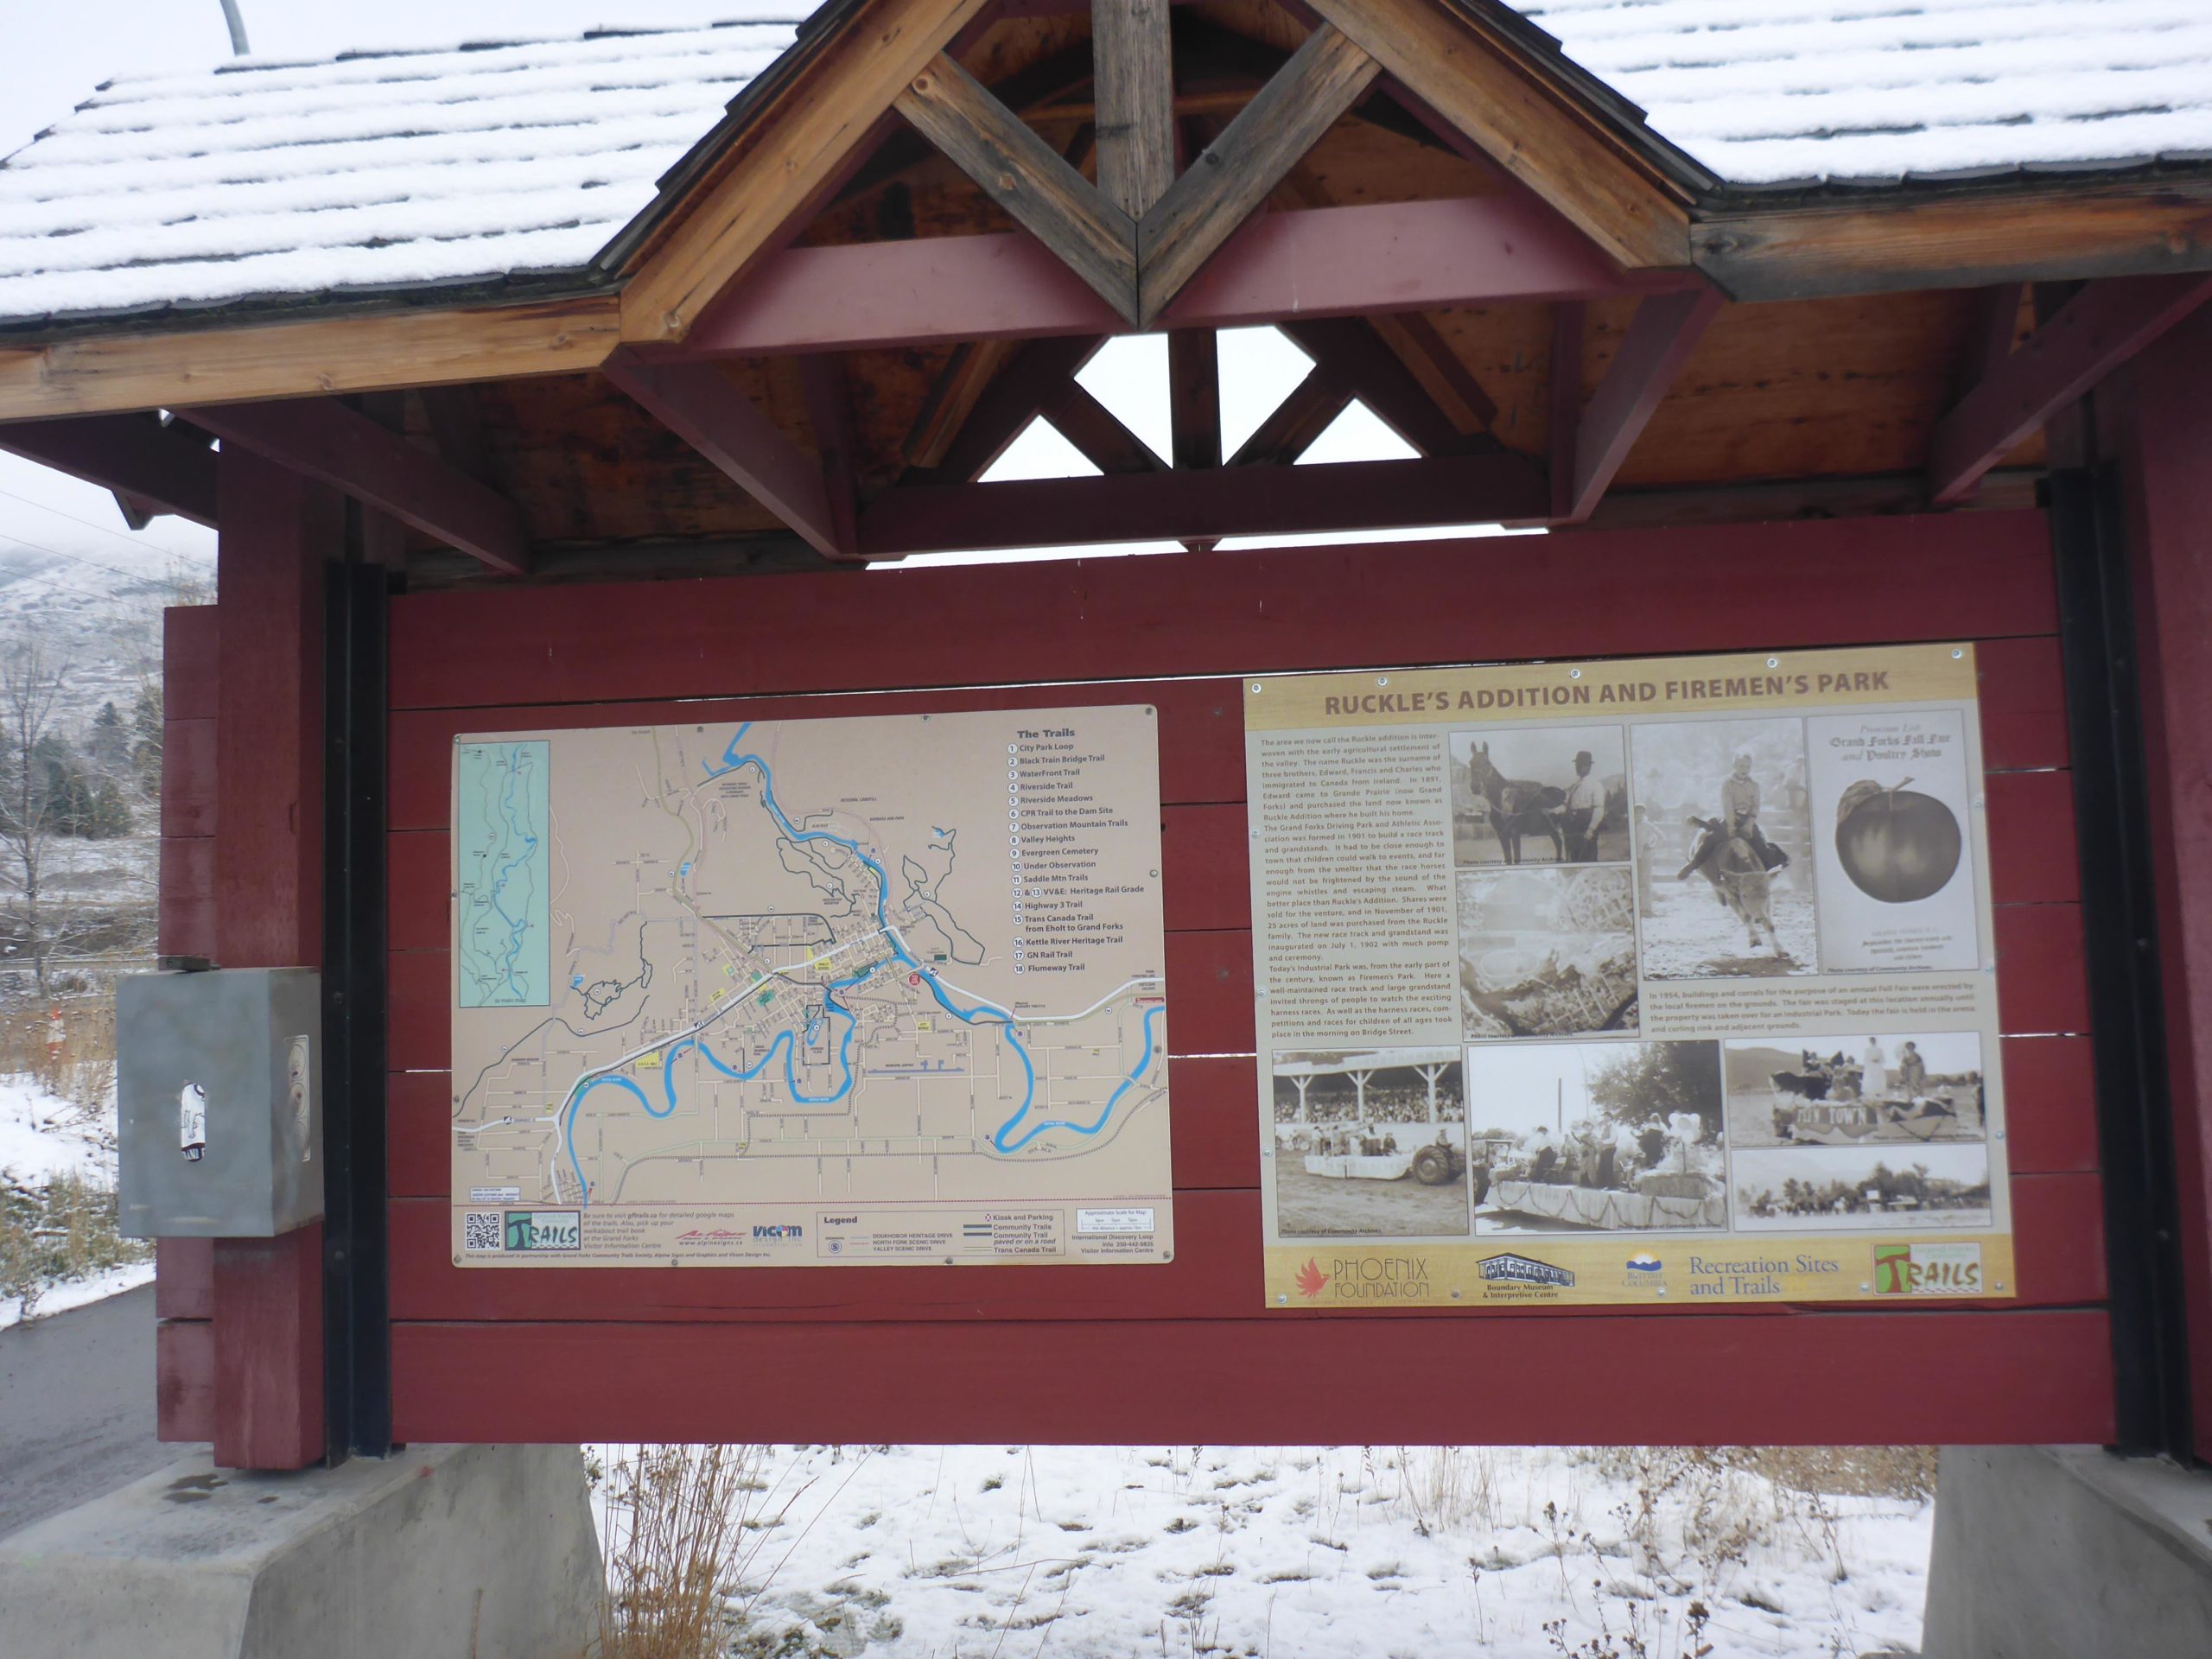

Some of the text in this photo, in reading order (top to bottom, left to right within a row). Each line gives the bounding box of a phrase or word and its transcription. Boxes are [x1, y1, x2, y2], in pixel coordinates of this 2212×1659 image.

[1325, 671, 1889, 715] RUCKLE'S ADDITION AND FIREMEN'S PARK
[1017, 728, 1076, 739] The Trails
[1019, 743, 1034, 753] City
[1054, 742, 1074, 752] Loop
[1061, 755, 1087, 765] Bridge
[1020, 769, 1062, 778] WaterFront
[1020, 782, 1055, 791] Riverside
[1057, 781, 1073, 790] Trail
[1020, 795, 1055, 804] Riverside
[1057, 794, 1093, 803] Meadows
[1020, 821, 1068, 830] Observation
[1069, 820, 1107, 829] Mountain
[1326, 822, 1355, 830] Driving
[1021, 835, 1044, 844] Valley
[1045, 835, 1075, 844] Heights
[1021, 848, 1060, 858] Evergreen
[1061, 847, 1098, 856] Cemetery
[1048, 860, 1096, 868] Observation
[1070, 887, 1103, 896] Heritage
[1121, 885, 1145, 893] Grade
[1025, 901, 1058, 911] Highway
[1046, 913, 1076, 922] Canada
[1077, 923, 1101, 931] Grand
[1050, 937, 1070, 945] River
[1071, 936, 1105, 946] Heritage
[1027, 963, 1067, 973] Flumeway
[1667, 1025, 1695, 1033] curling
[1730, 1023, 1764, 1032] adjacent
[1766, 1022, 1802, 1031] grounds.
[1316, 1029, 1349, 1038] morning
[824, 1216, 858, 1224] Legend
[508, 1218, 578, 1250] TRAILS
[1334, 1258, 1428, 1281] PHOENIX
[1689, 1255, 1839, 1274] Recreation Sites
[1875, 1252, 1978, 1293] TRAILS
[1334, 1281, 1429, 1298] FOUNDATION
[1690, 1275, 1781, 1295] and Trails
